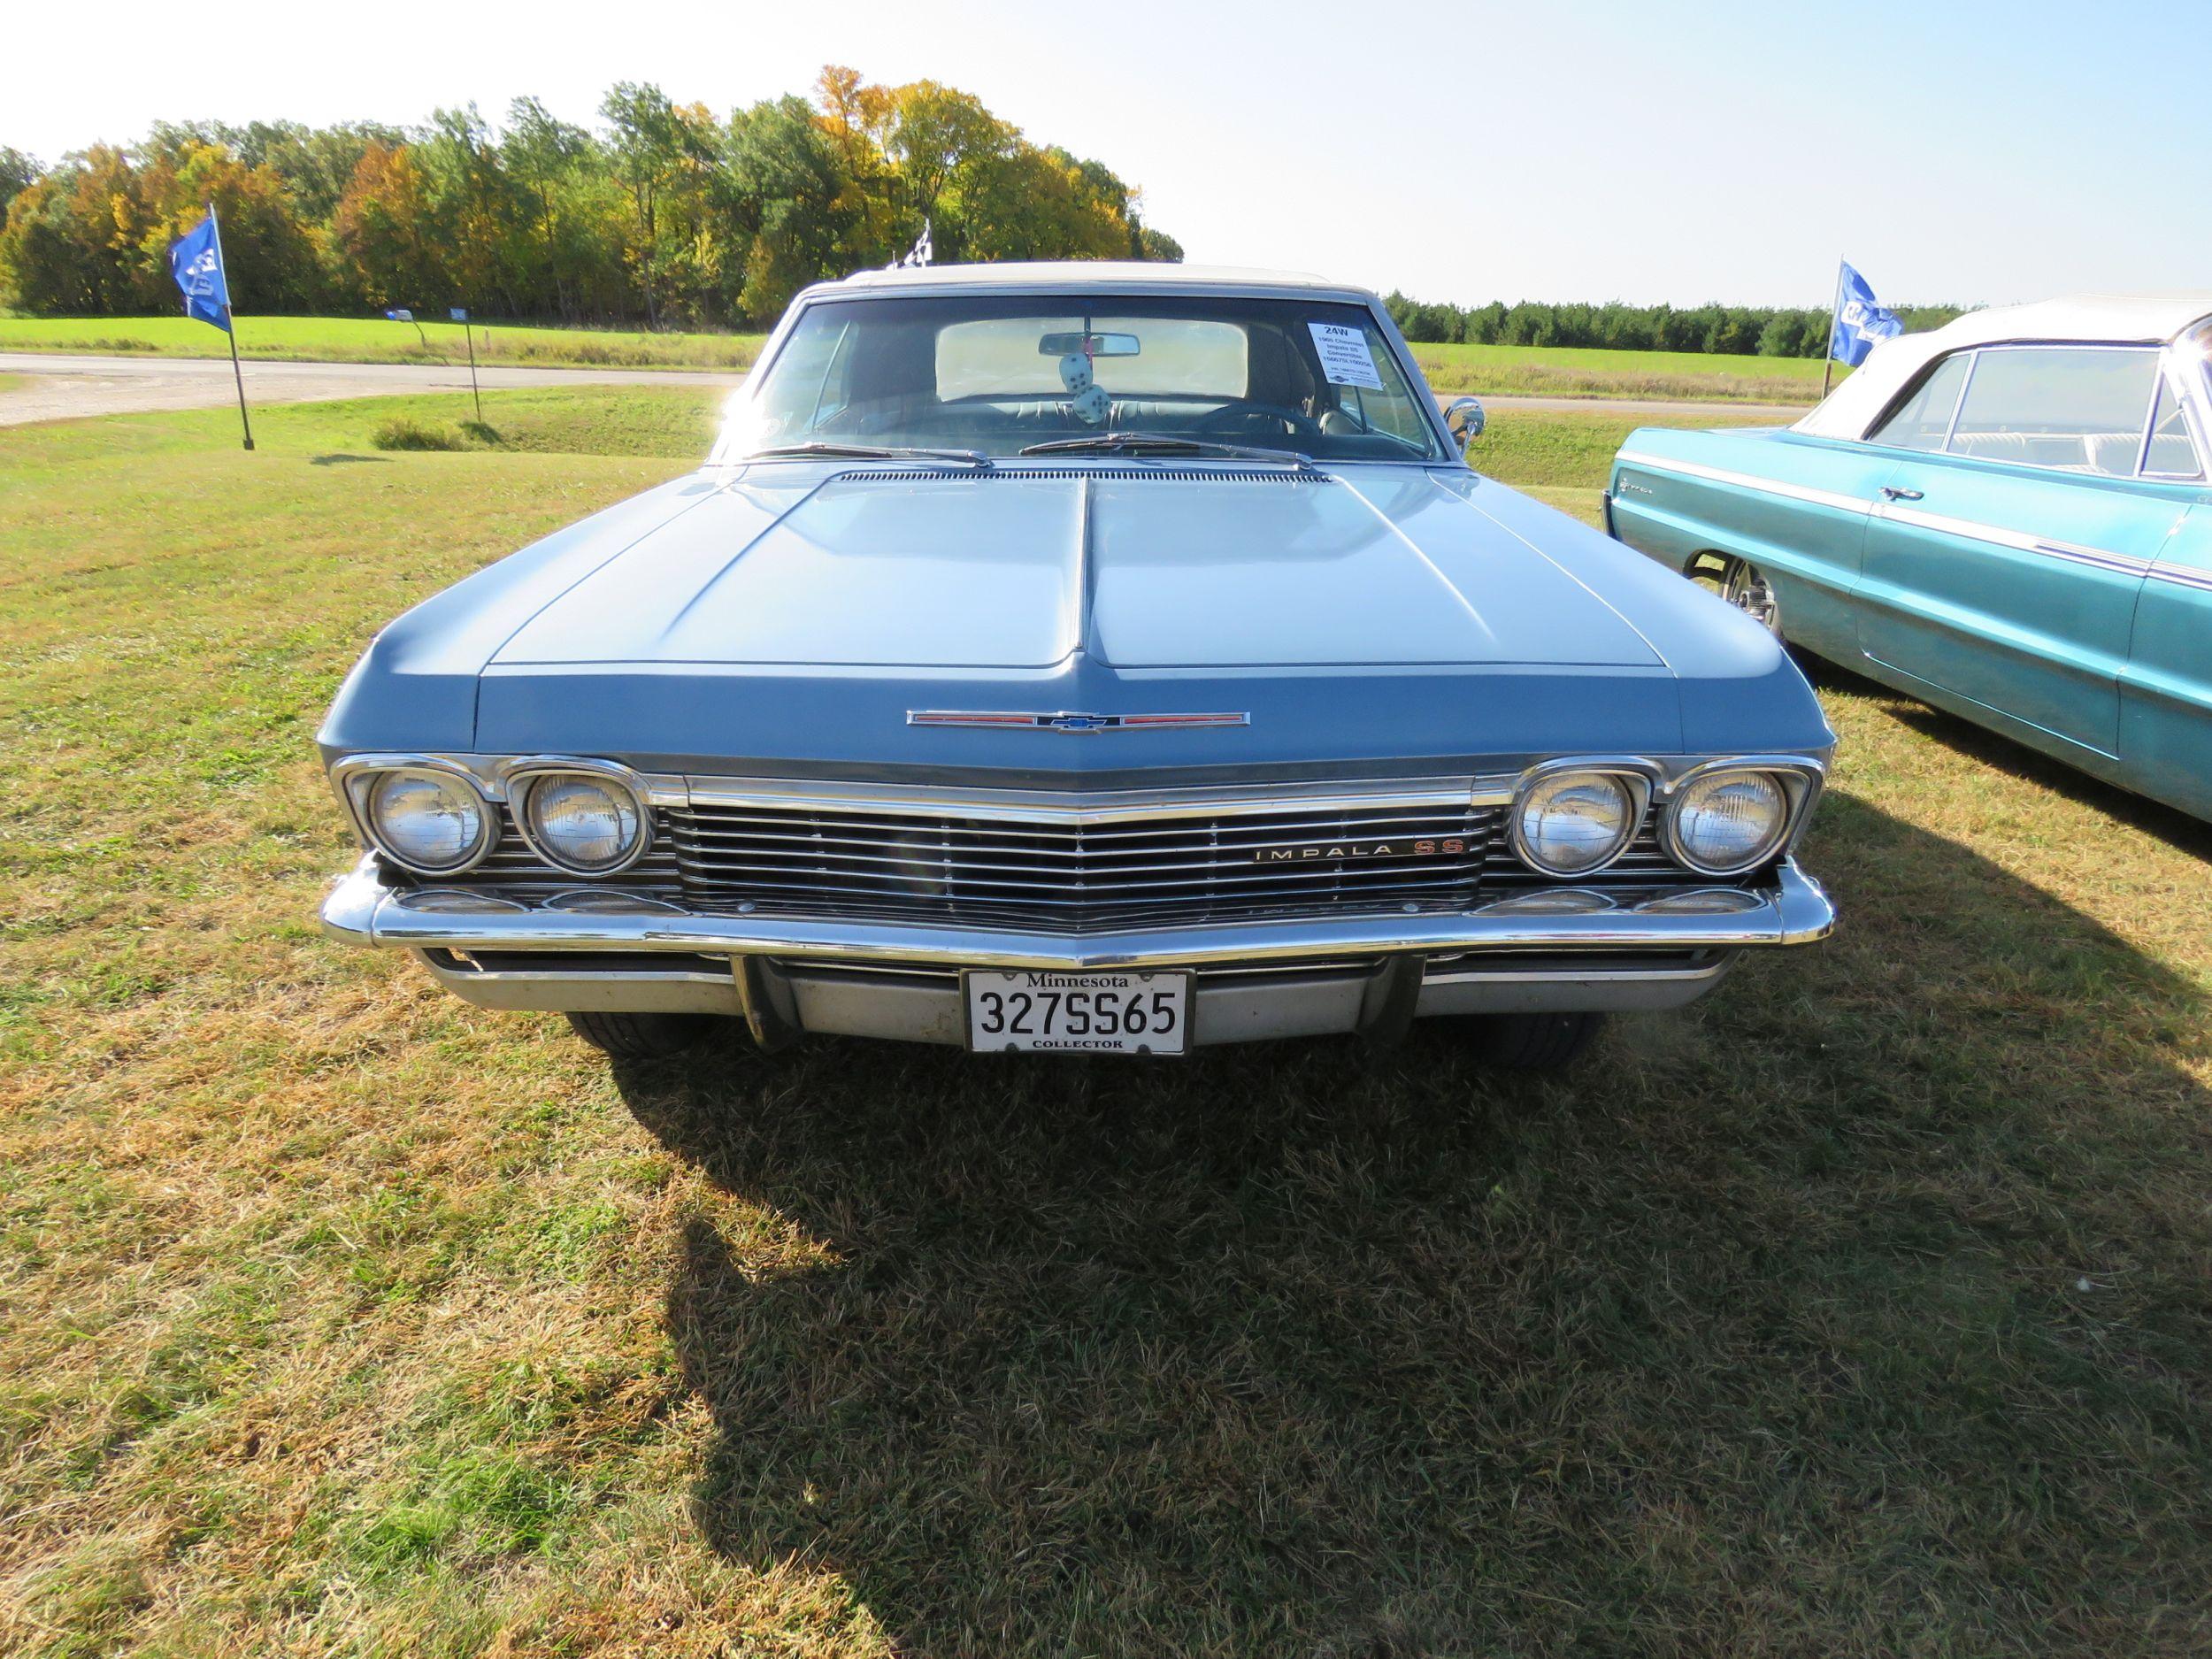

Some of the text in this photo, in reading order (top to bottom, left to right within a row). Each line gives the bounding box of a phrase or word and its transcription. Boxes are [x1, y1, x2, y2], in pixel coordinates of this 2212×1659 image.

[1324, 326, 1348, 336] 24W
[1256, 839, 1464, 860] IMPALA SS
[1026, 972, 1129, 988] Minnesota
[979, 992, 1176, 1035] 327SS65
[1033, 1040, 1124, 1048] COLLECTOR
